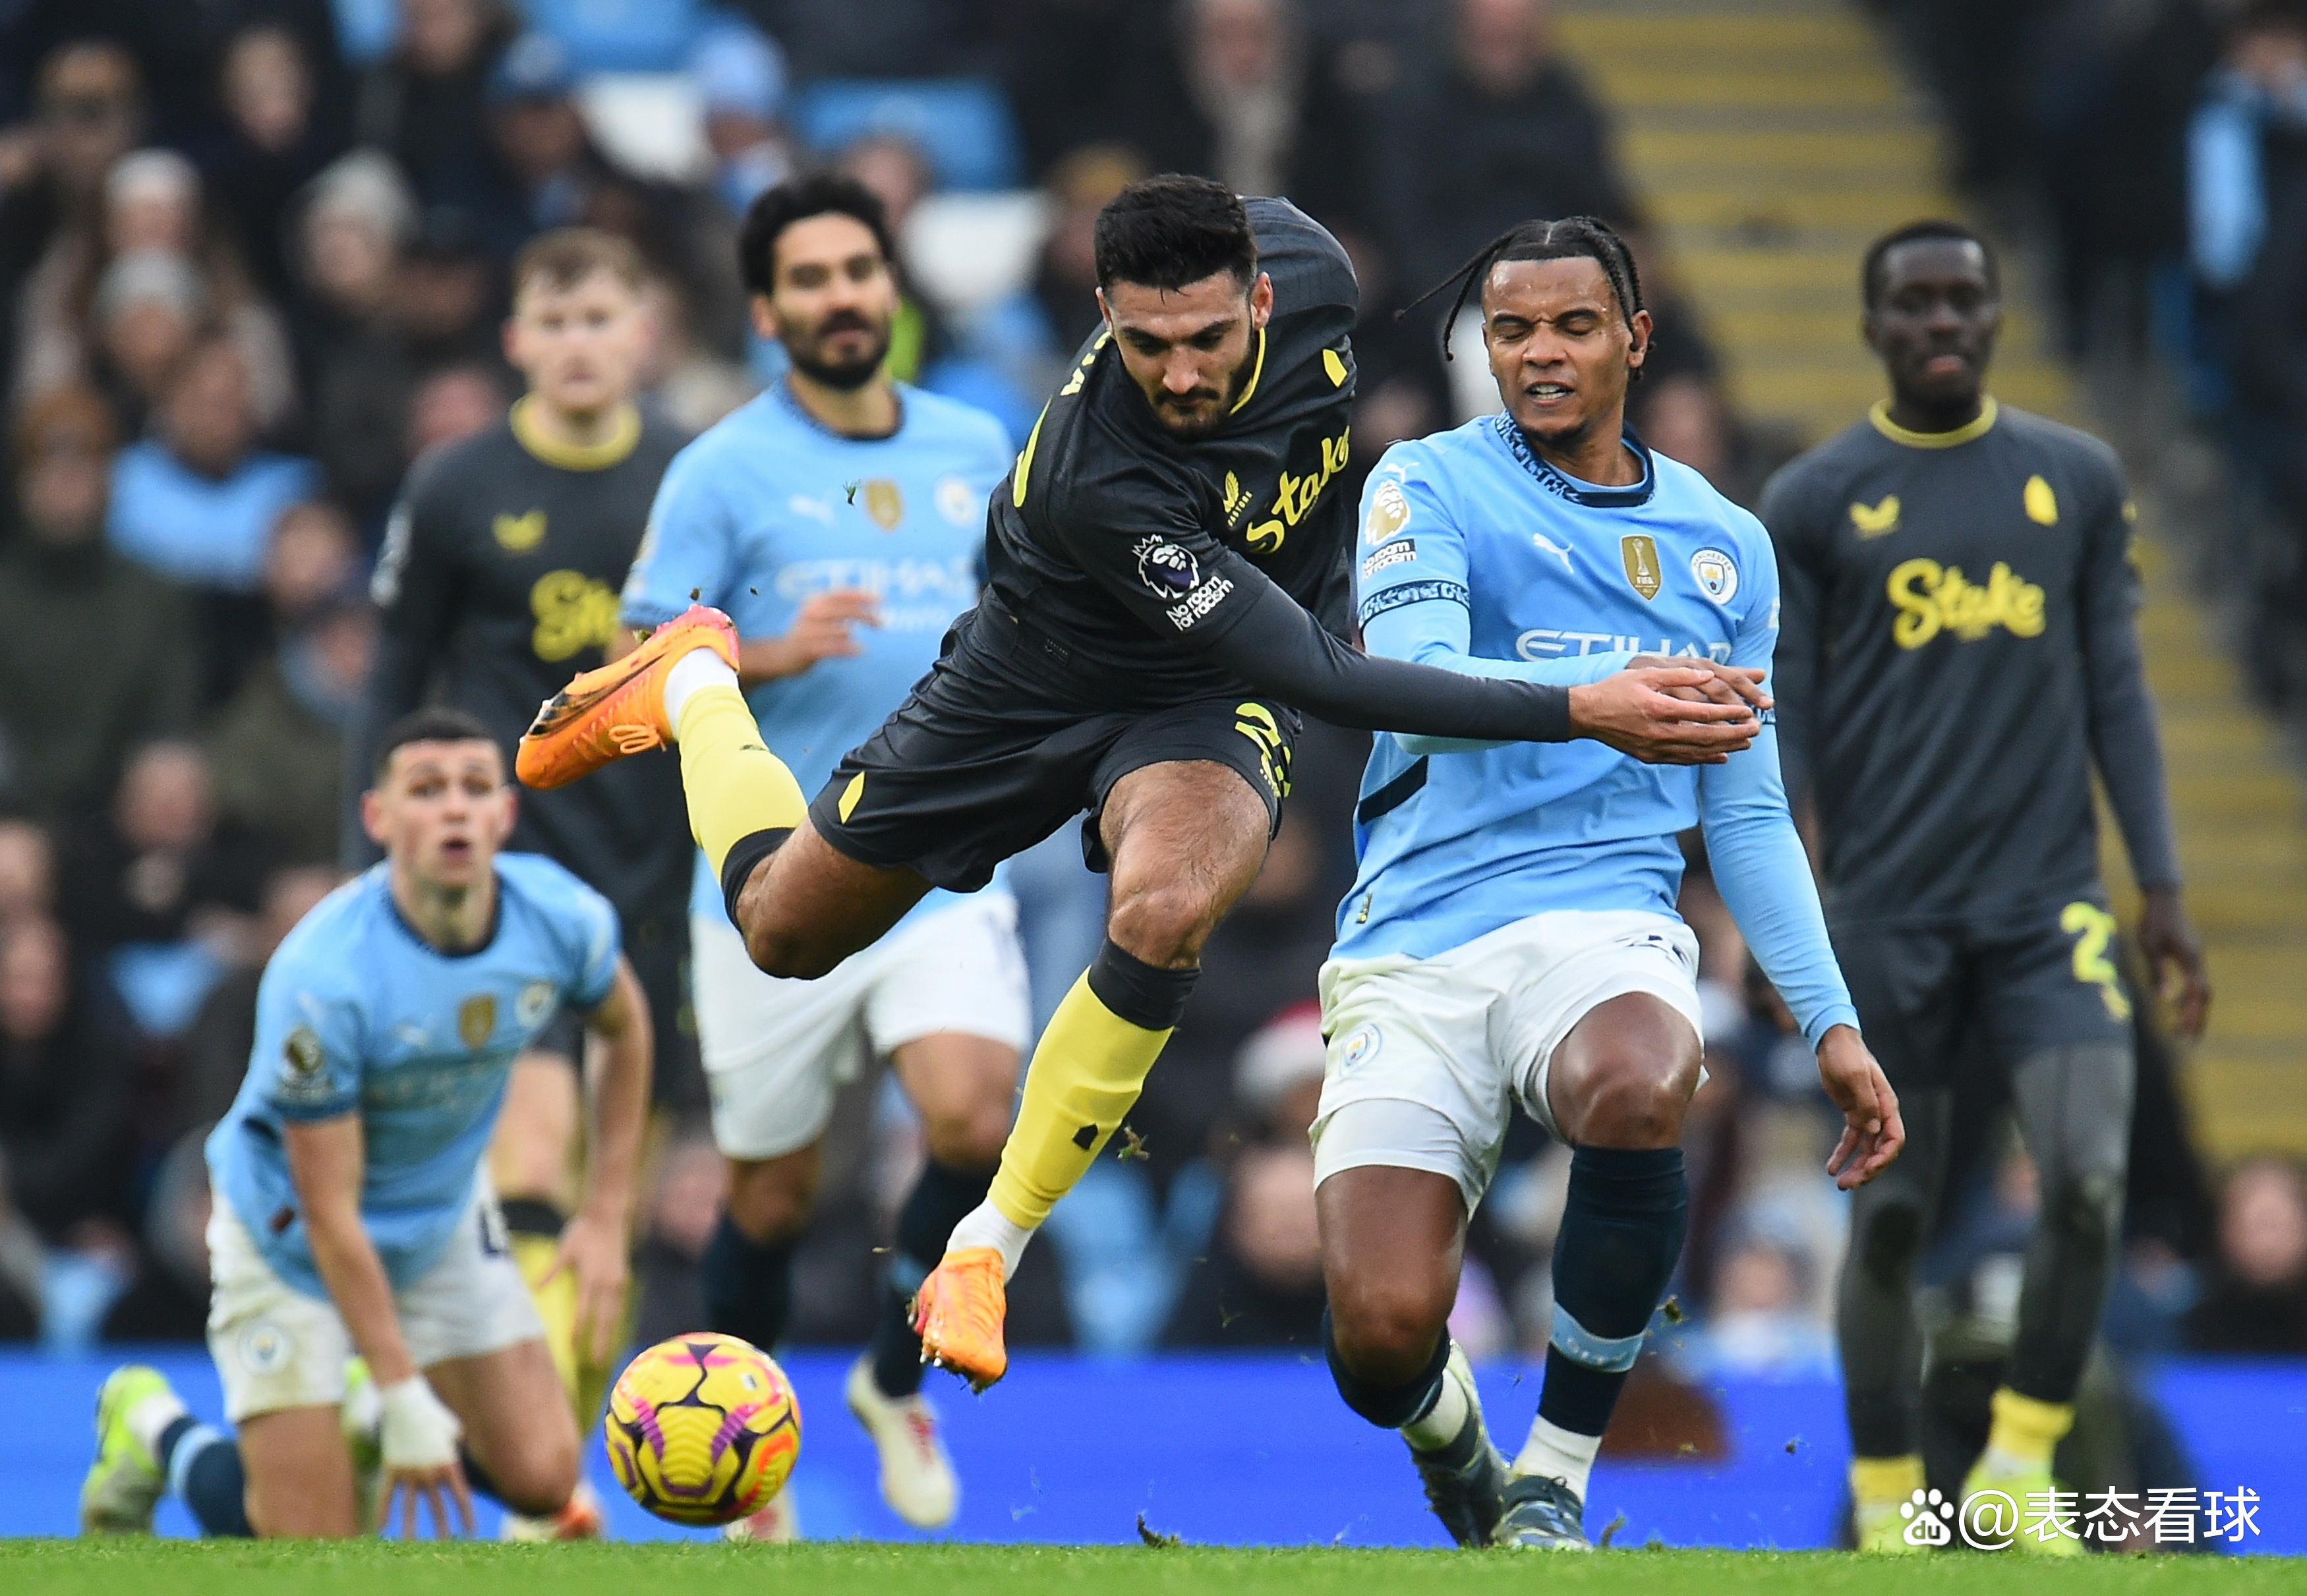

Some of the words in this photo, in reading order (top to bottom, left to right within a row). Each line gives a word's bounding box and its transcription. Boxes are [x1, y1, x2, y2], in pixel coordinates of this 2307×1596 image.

[1374, 542, 1411, 563] room
[1165, 604, 1189, 621] No
[1186, 575, 1222, 610] room
[1173, 612, 1195, 631] for
[1192, 579, 1235, 619] racism
[1886, 557, 2045, 650] Stake
